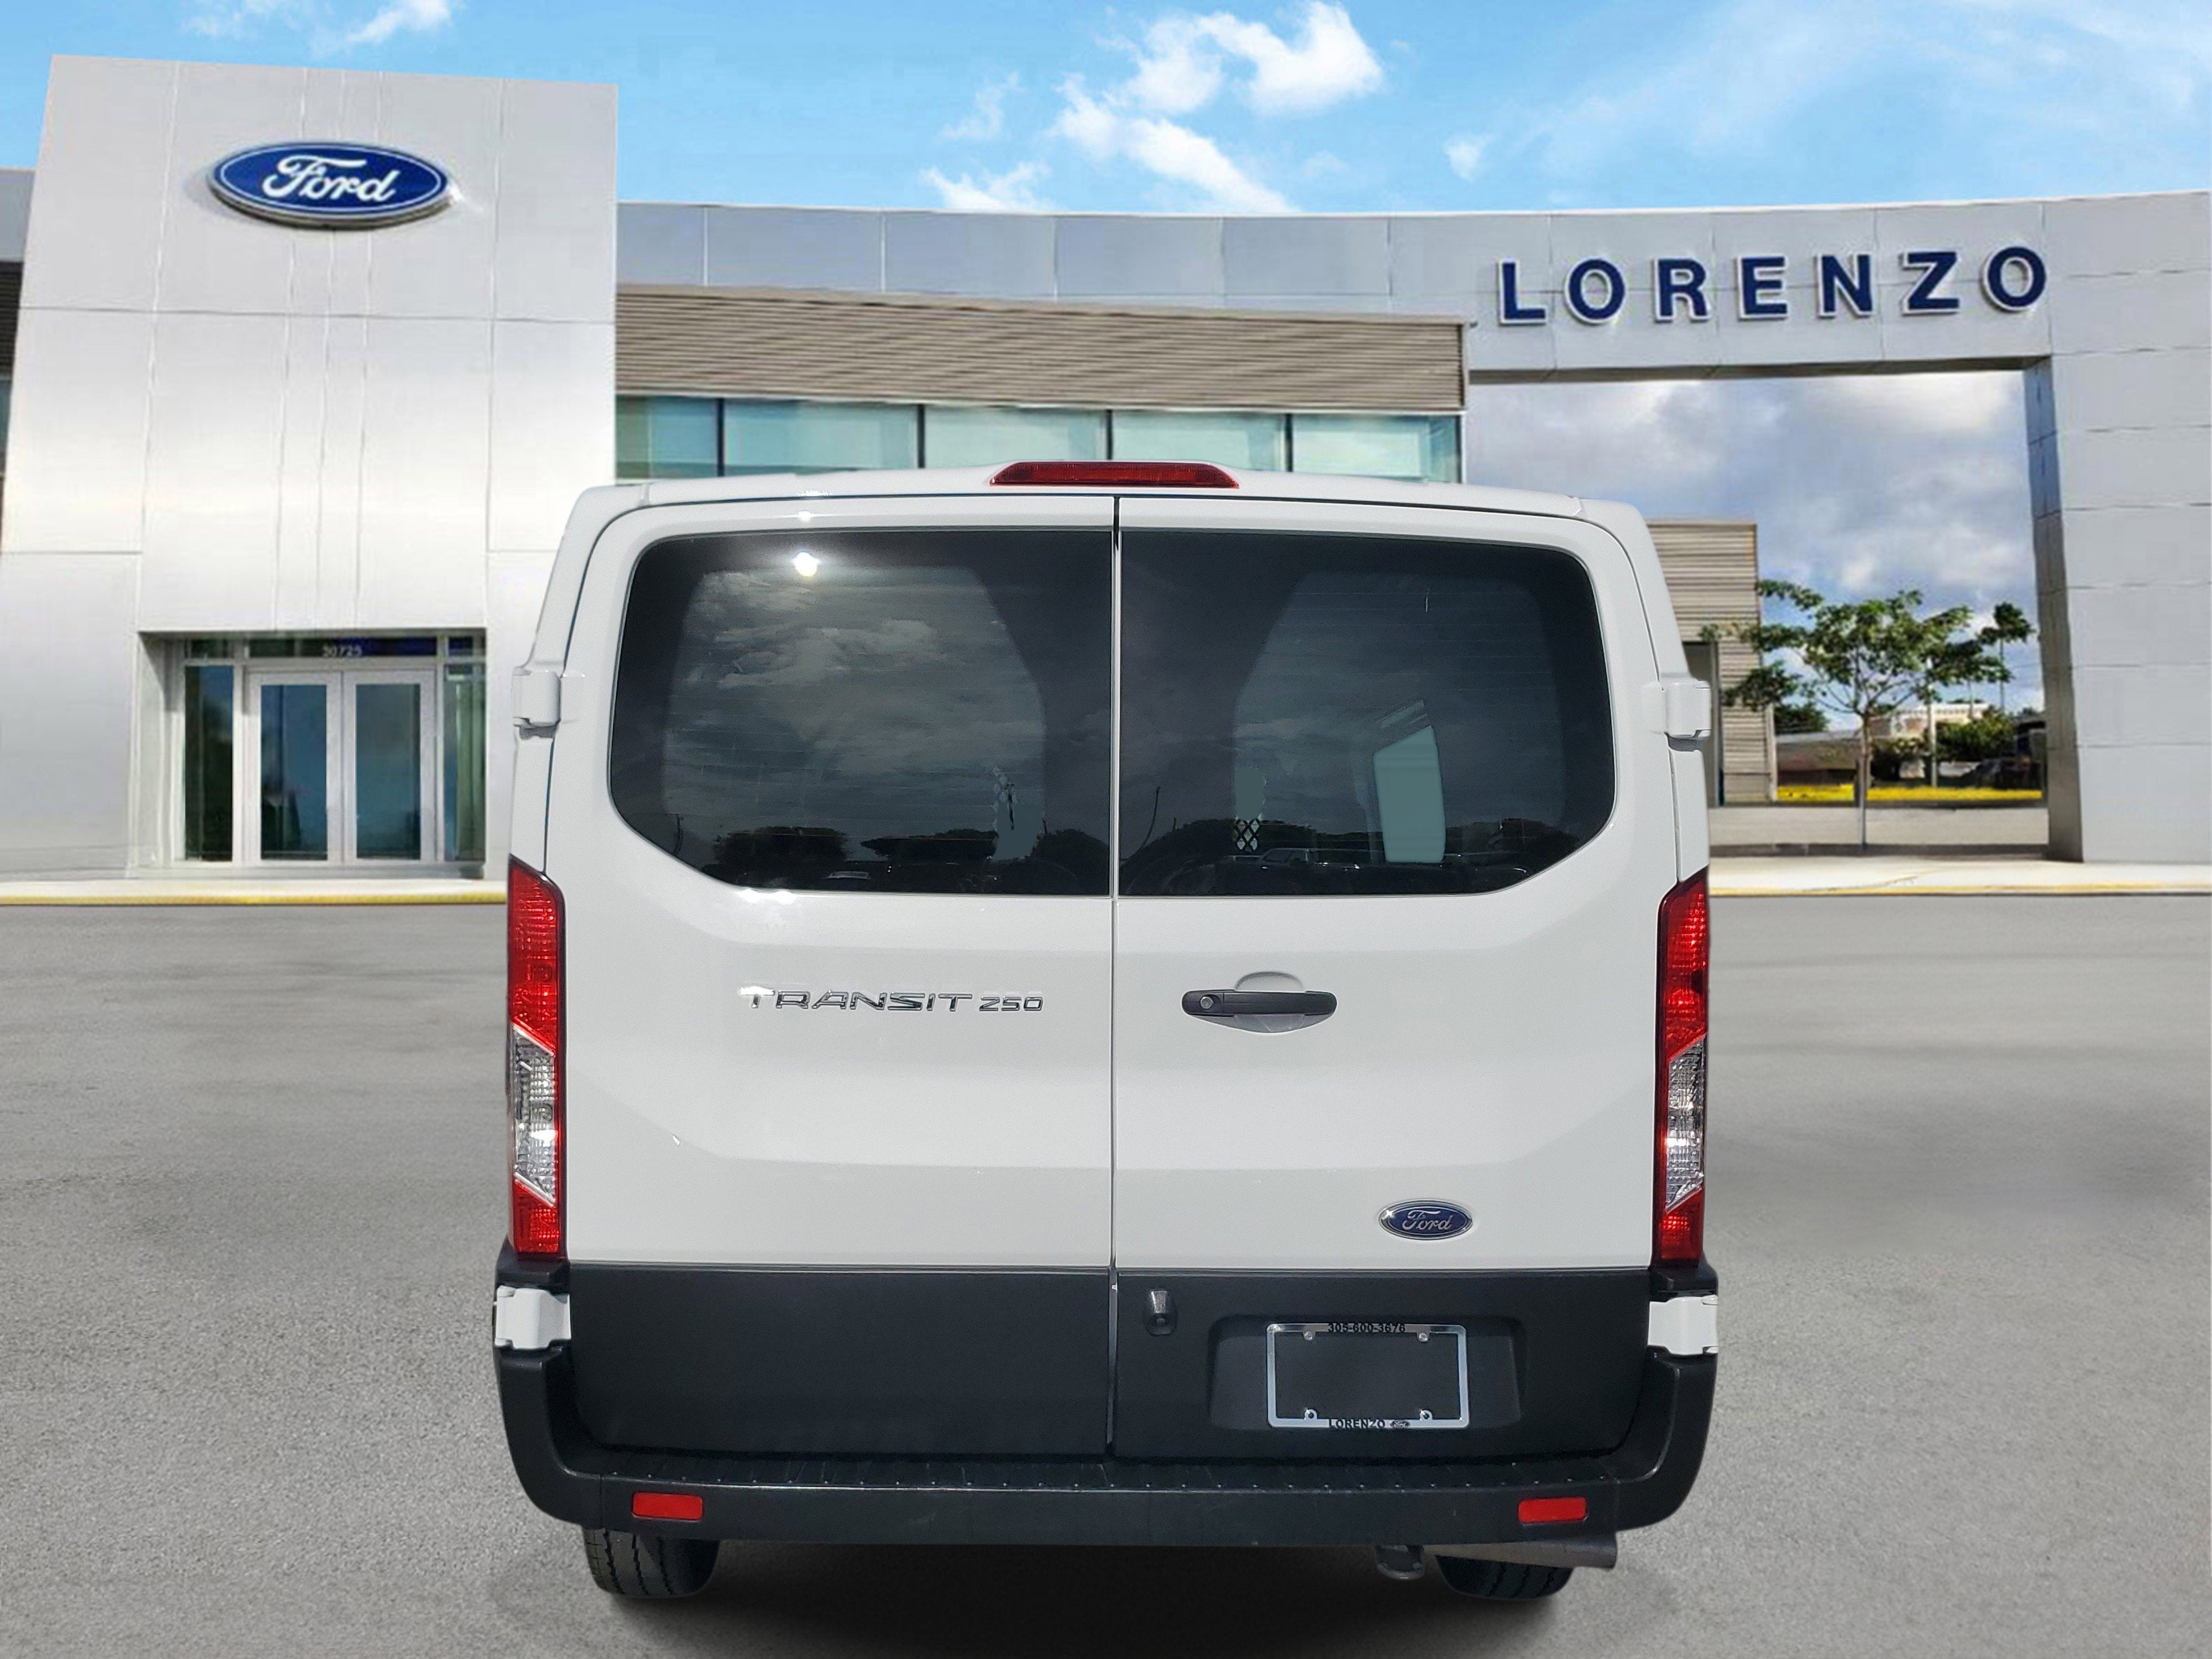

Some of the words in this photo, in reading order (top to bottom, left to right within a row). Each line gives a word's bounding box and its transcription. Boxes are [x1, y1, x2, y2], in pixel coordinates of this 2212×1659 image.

[262, 154, 400, 202] Ford
[1497, 246, 2047, 325] LORENZO
[738, 986, 973, 1011] TRANSIT
[979, 996, 1044, 1011] 250
[1401, 1209, 1453, 1231] Ford
[1328, 1418, 1386, 1429] LORENZO
